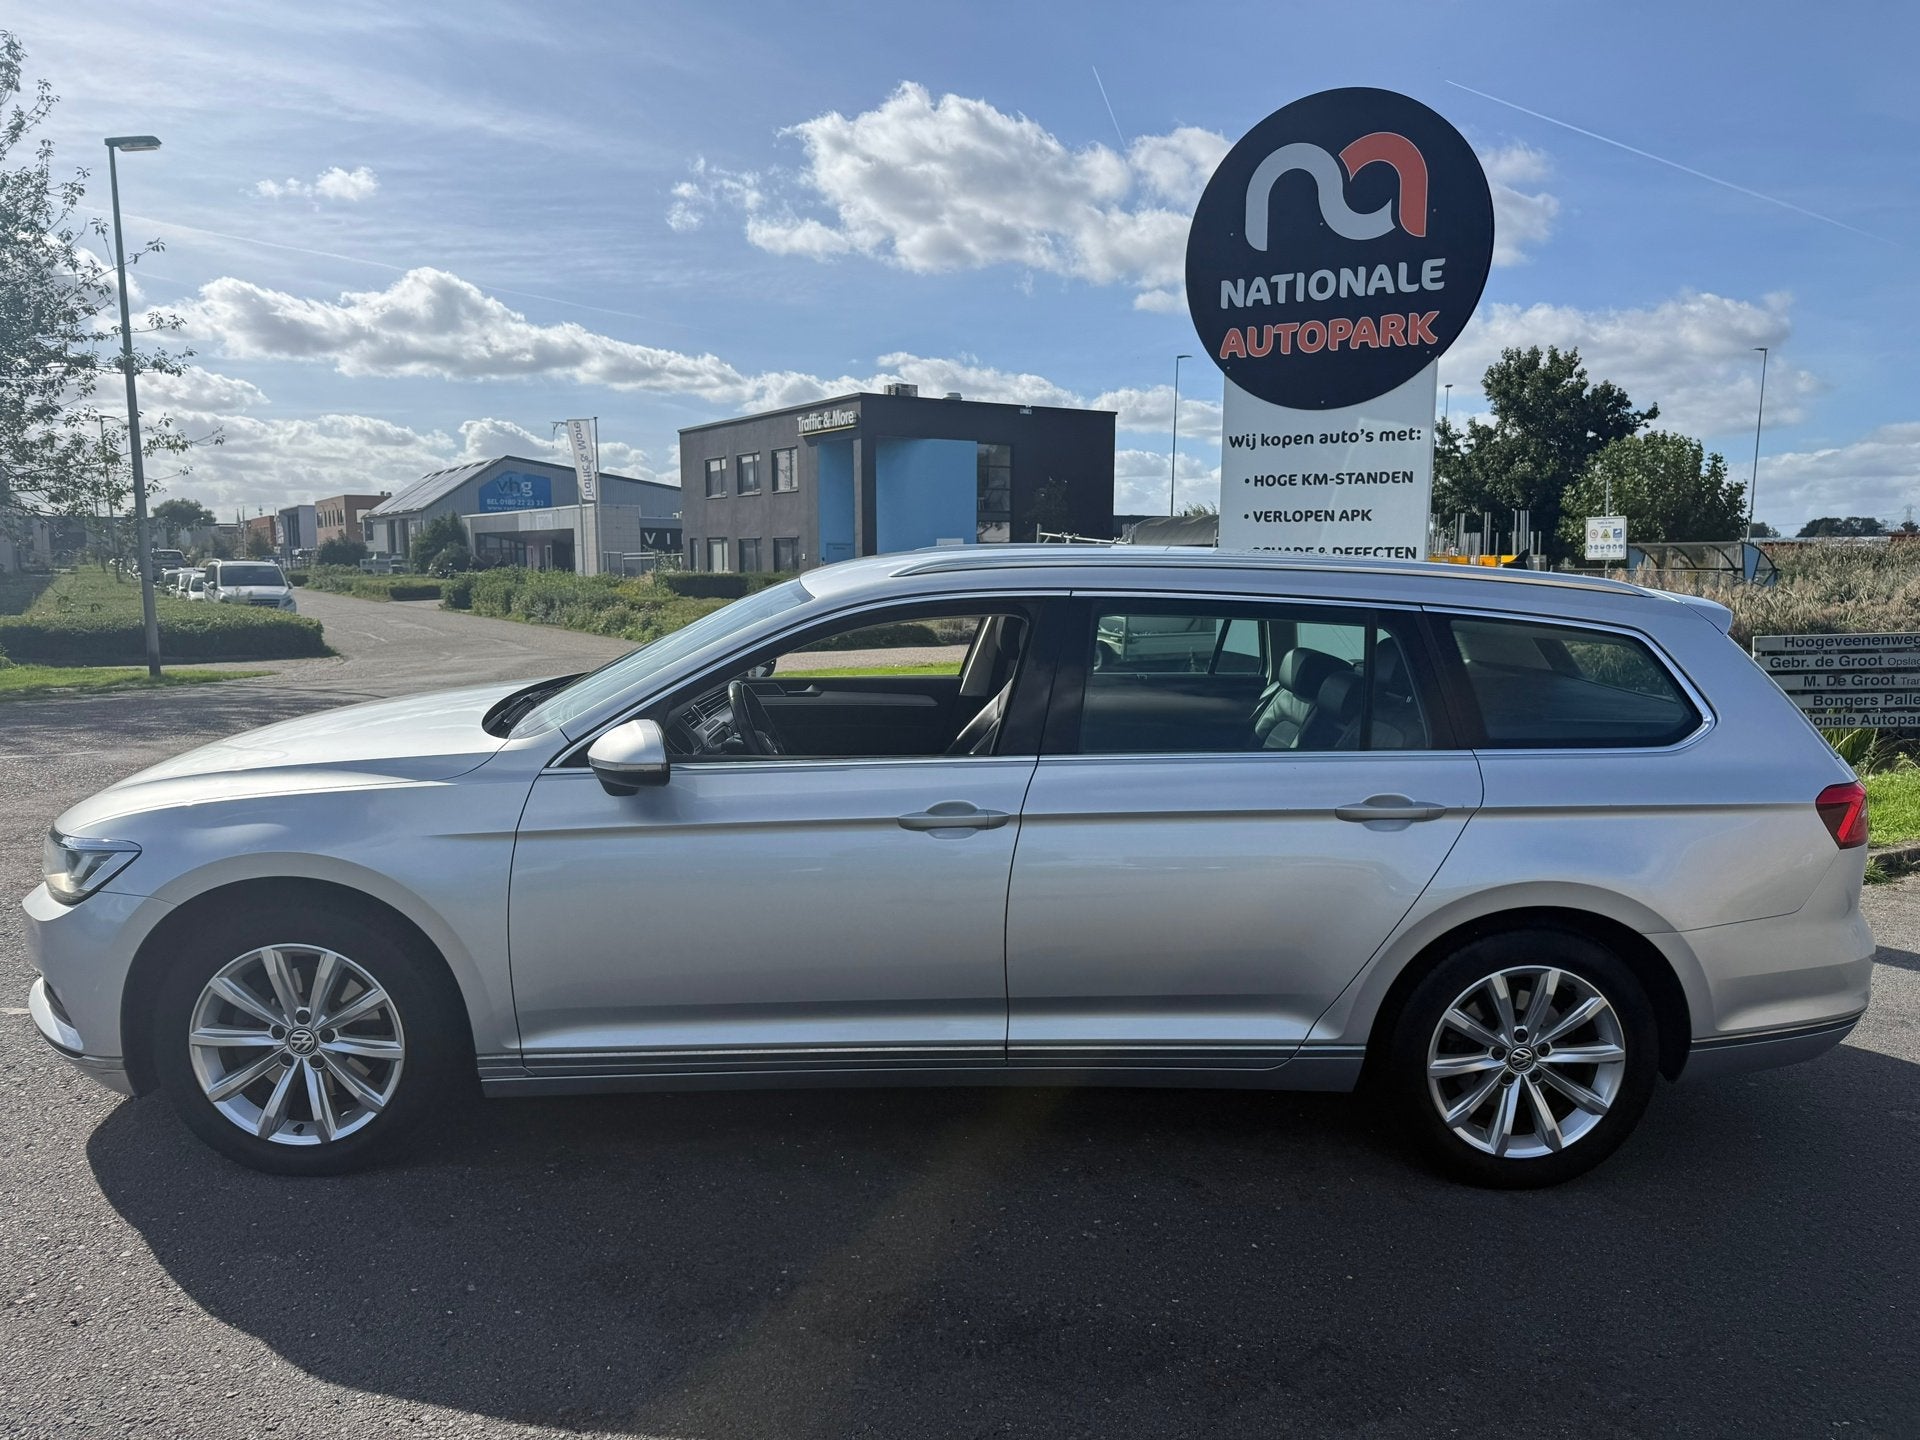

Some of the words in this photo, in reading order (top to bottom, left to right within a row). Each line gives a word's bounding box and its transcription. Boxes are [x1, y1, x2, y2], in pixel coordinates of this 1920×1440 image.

[1220, 258, 1446, 309] NATIONALE
[1219, 311, 1440, 359] AUTOPARK
[797, 413, 823, 432] Traffic
[823, 411, 832, 428] &
[832, 409, 856, 426] More
[1229, 433, 1257, 450] Wij
[1261, 433, 1314, 448] kopen
[1379, 427, 1422, 442] met:
[1254, 473, 1297, 487] HOGE
[1302, 470, 1413, 486] KM-STANDEN
[1253, 510, 1335, 523] VERLOPEN
[1338, 509, 1372, 522] APK
[1784, 636, 1920, 649] Hoogeveenenweg
[1770, 657, 1810, 669] Gebr.
[1815, 656, 1834, 668] de
[1839, 655, 1883, 667] Groot
[1803, 676, 1820, 687] M.
[1826, 675, 1846, 687] De
[1851, 674, 1896, 686] Groot
[1813, 695, 1878, 708] Bongers
[1884, 694, 1920, 706] Palle
